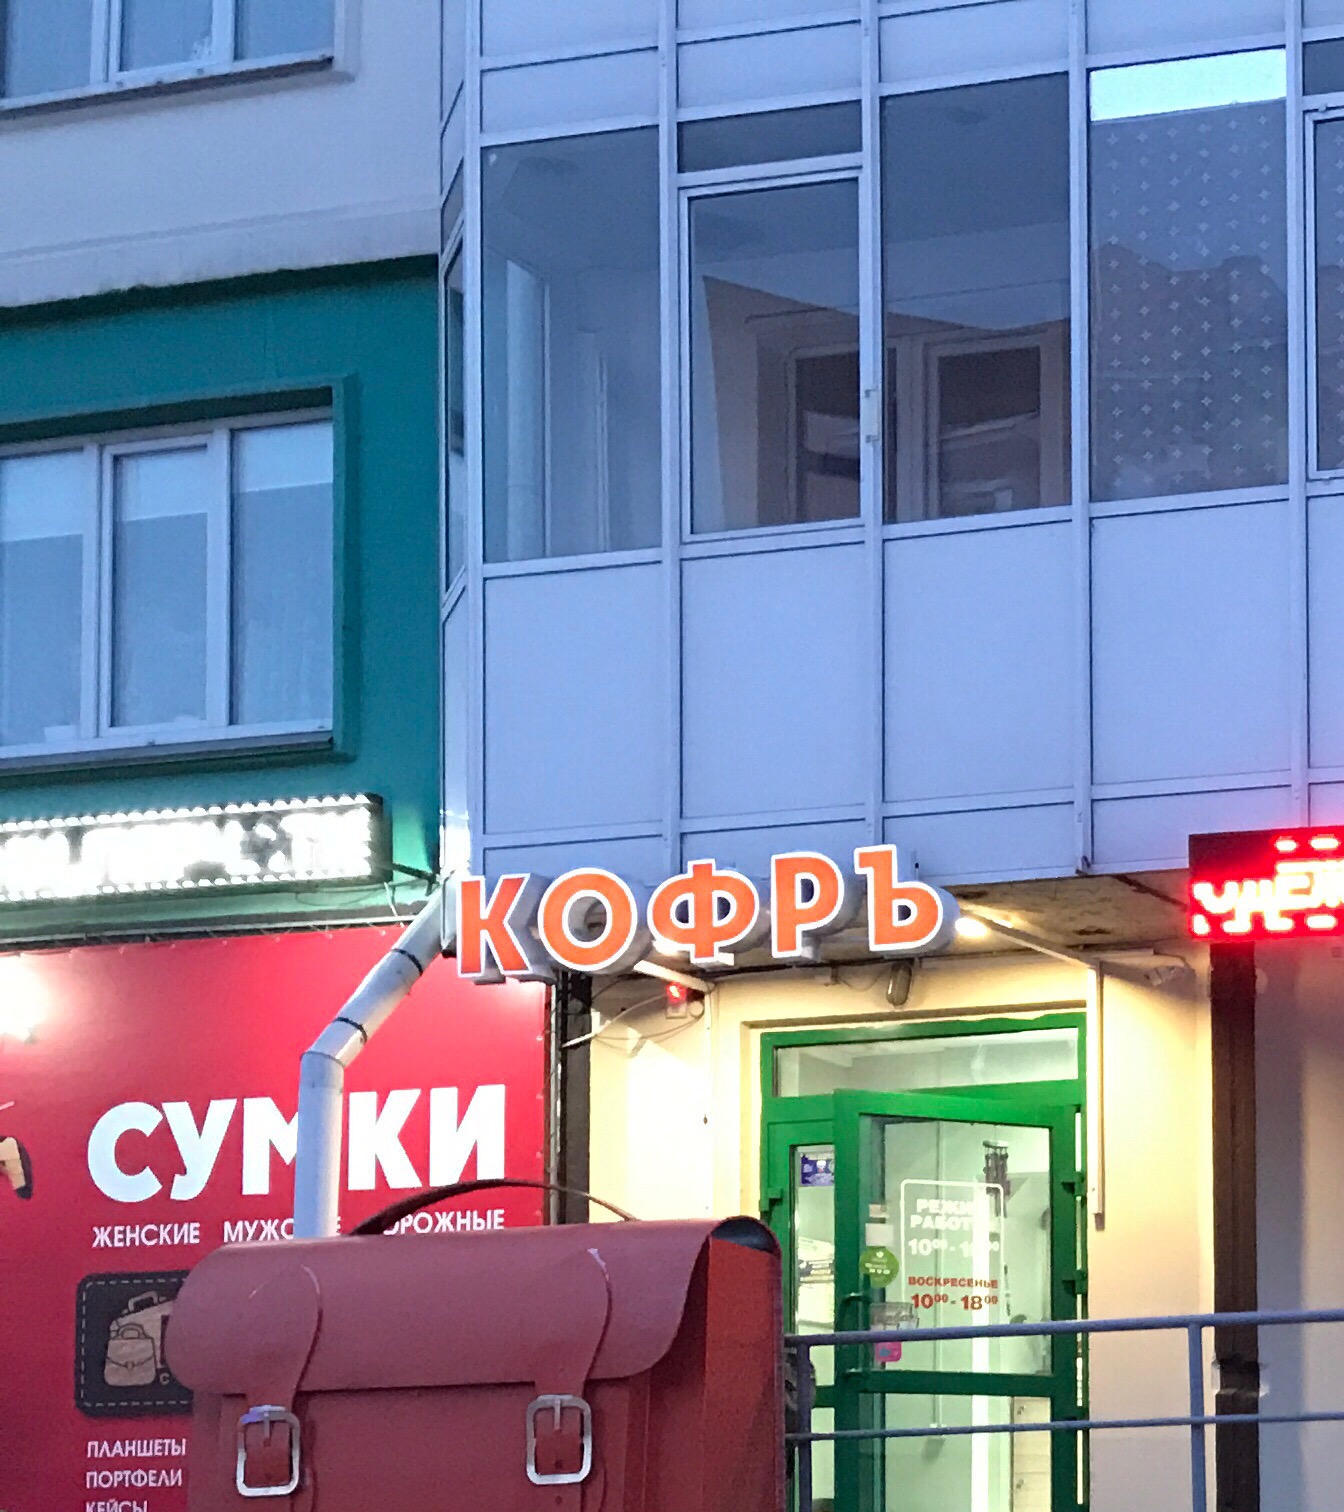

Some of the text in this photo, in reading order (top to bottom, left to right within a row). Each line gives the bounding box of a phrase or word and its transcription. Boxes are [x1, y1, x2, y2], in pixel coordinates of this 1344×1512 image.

[457, 844, 944, 977] КОФРЪ
[87, 1084, 506, 1202] СУМКИ
[916, 1199, 974, 1214] РЕЖИ
[92, 1222, 201, 1248] ЖЕНСКИЕ
[383, 1209, 505, 1236] РОЖНЫЕ
[910, 1214, 974, 1231] РАБОТ
[908, 1276, 998, 1289] ВОСКРЕСЕНЬЕ
[87, 1438, 187, 1459] ПЛАНШЕТЫ
[86, 1469, 183, 1489] ПОРТФЕЛИ
